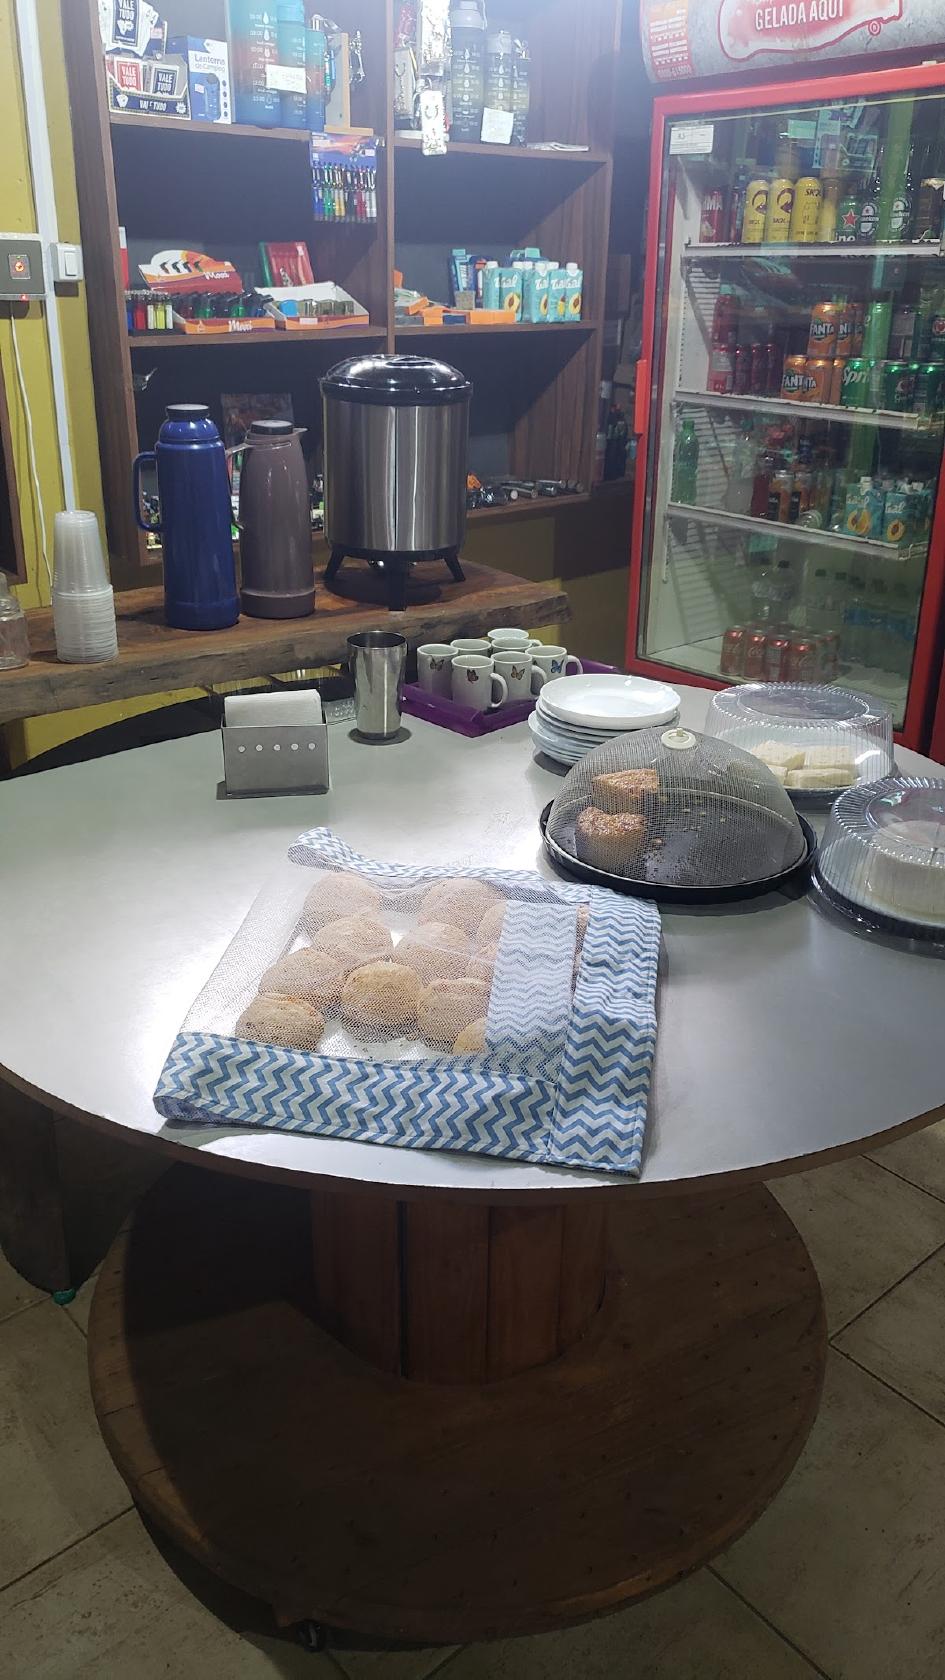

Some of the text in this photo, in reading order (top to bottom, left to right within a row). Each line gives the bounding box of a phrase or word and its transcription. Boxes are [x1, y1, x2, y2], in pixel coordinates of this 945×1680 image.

[755, 3, 806, 31] GELADA
[194, 53, 225, 65] Lanterna
[121, 65, 137, 76] VALE
[158, 73, 173, 83] VALE
[157, 82, 172, 92] TUDO
[810, 323, 834, 335] FANTA
